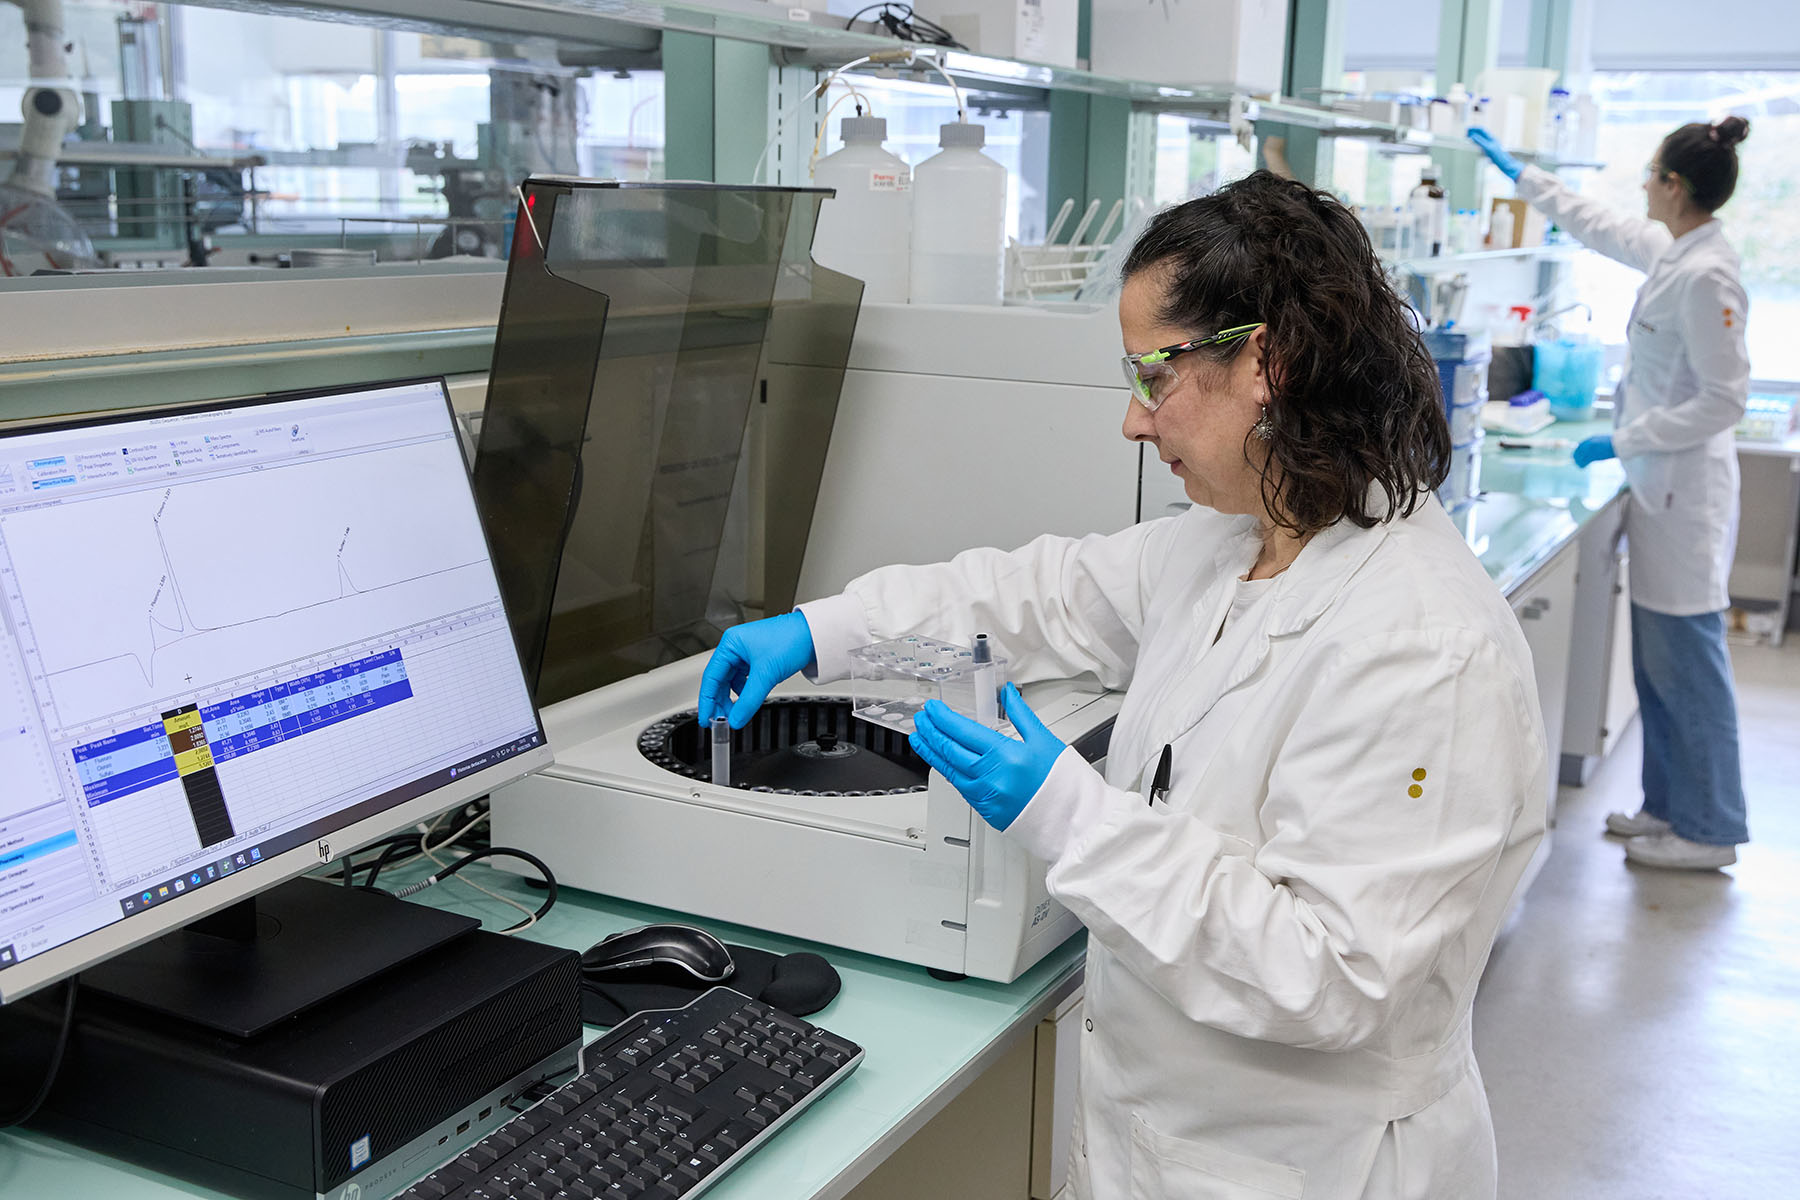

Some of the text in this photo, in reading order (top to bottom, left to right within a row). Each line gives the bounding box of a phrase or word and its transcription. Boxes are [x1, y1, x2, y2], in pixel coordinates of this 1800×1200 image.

[174, 714, 190, 722] Amount
[84, 780, 106, 791] Maximum
[86, 788, 108, 798] Minimum
